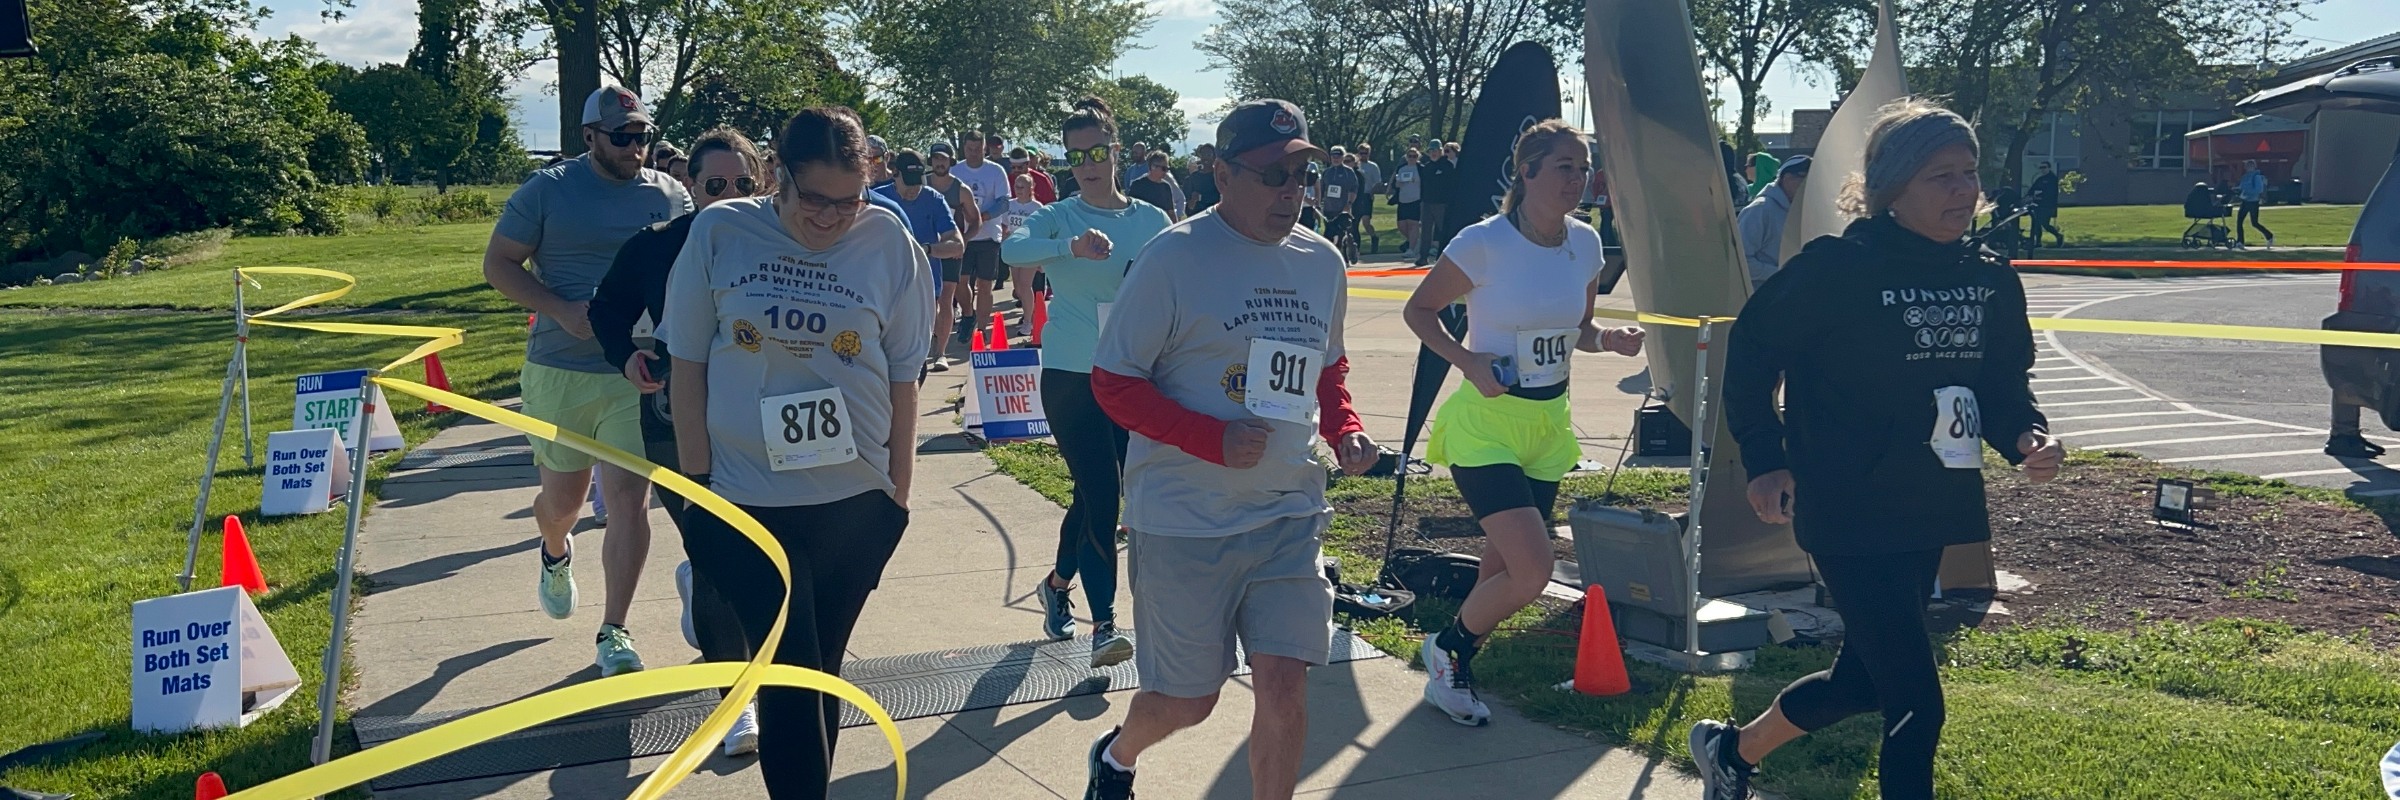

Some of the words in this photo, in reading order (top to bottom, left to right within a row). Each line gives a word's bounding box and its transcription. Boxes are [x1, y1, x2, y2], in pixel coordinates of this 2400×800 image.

[1010, 217, 1023, 226] 933
[759, 263, 838, 282] RUNNING
[799, 259, 827, 268] Annual
[730, 273, 769, 288] LAPS
[773, 275, 813, 289] WITH
[818, 283, 864, 304] LIONS
[766, 292, 784, 300] Park
[1881, 286, 1996, 306] RUNDUSKY
[1245, 298, 1309, 311] RUNNING
[764, 305, 827, 334] 100
[1223, 312, 1259, 332] LAPS
[1260, 312, 1293, 322] WITH
[1296, 313, 1328, 334] LIONS
[973, 352, 997, 367] RUN
[1533, 335, 1567, 366] 914
[1269, 350, 1307, 396] 911
[299, 376, 323, 392] RUN
[984, 373, 1037, 394] FINISH
[305, 397, 361, 421] START
[995, 394, 1032, 415] LINE
[781, 398, 841, 444] 878
[1027, 420, 1051, 435] RUN
[273, 451, 296, 461] Run
[300, 448, 328, 459] Over
[272, 464, 301, 475] Both
[304, 461, 325, 473] Set
[281, 477, 312, 490] Mats
[142, 629, 180, 648] Run
[187, 620, 231, 641] Over
[144, 649, 190, 673] Both
[196, 642, 229, 664] Set
[162, 672, 211, 696] Mats
